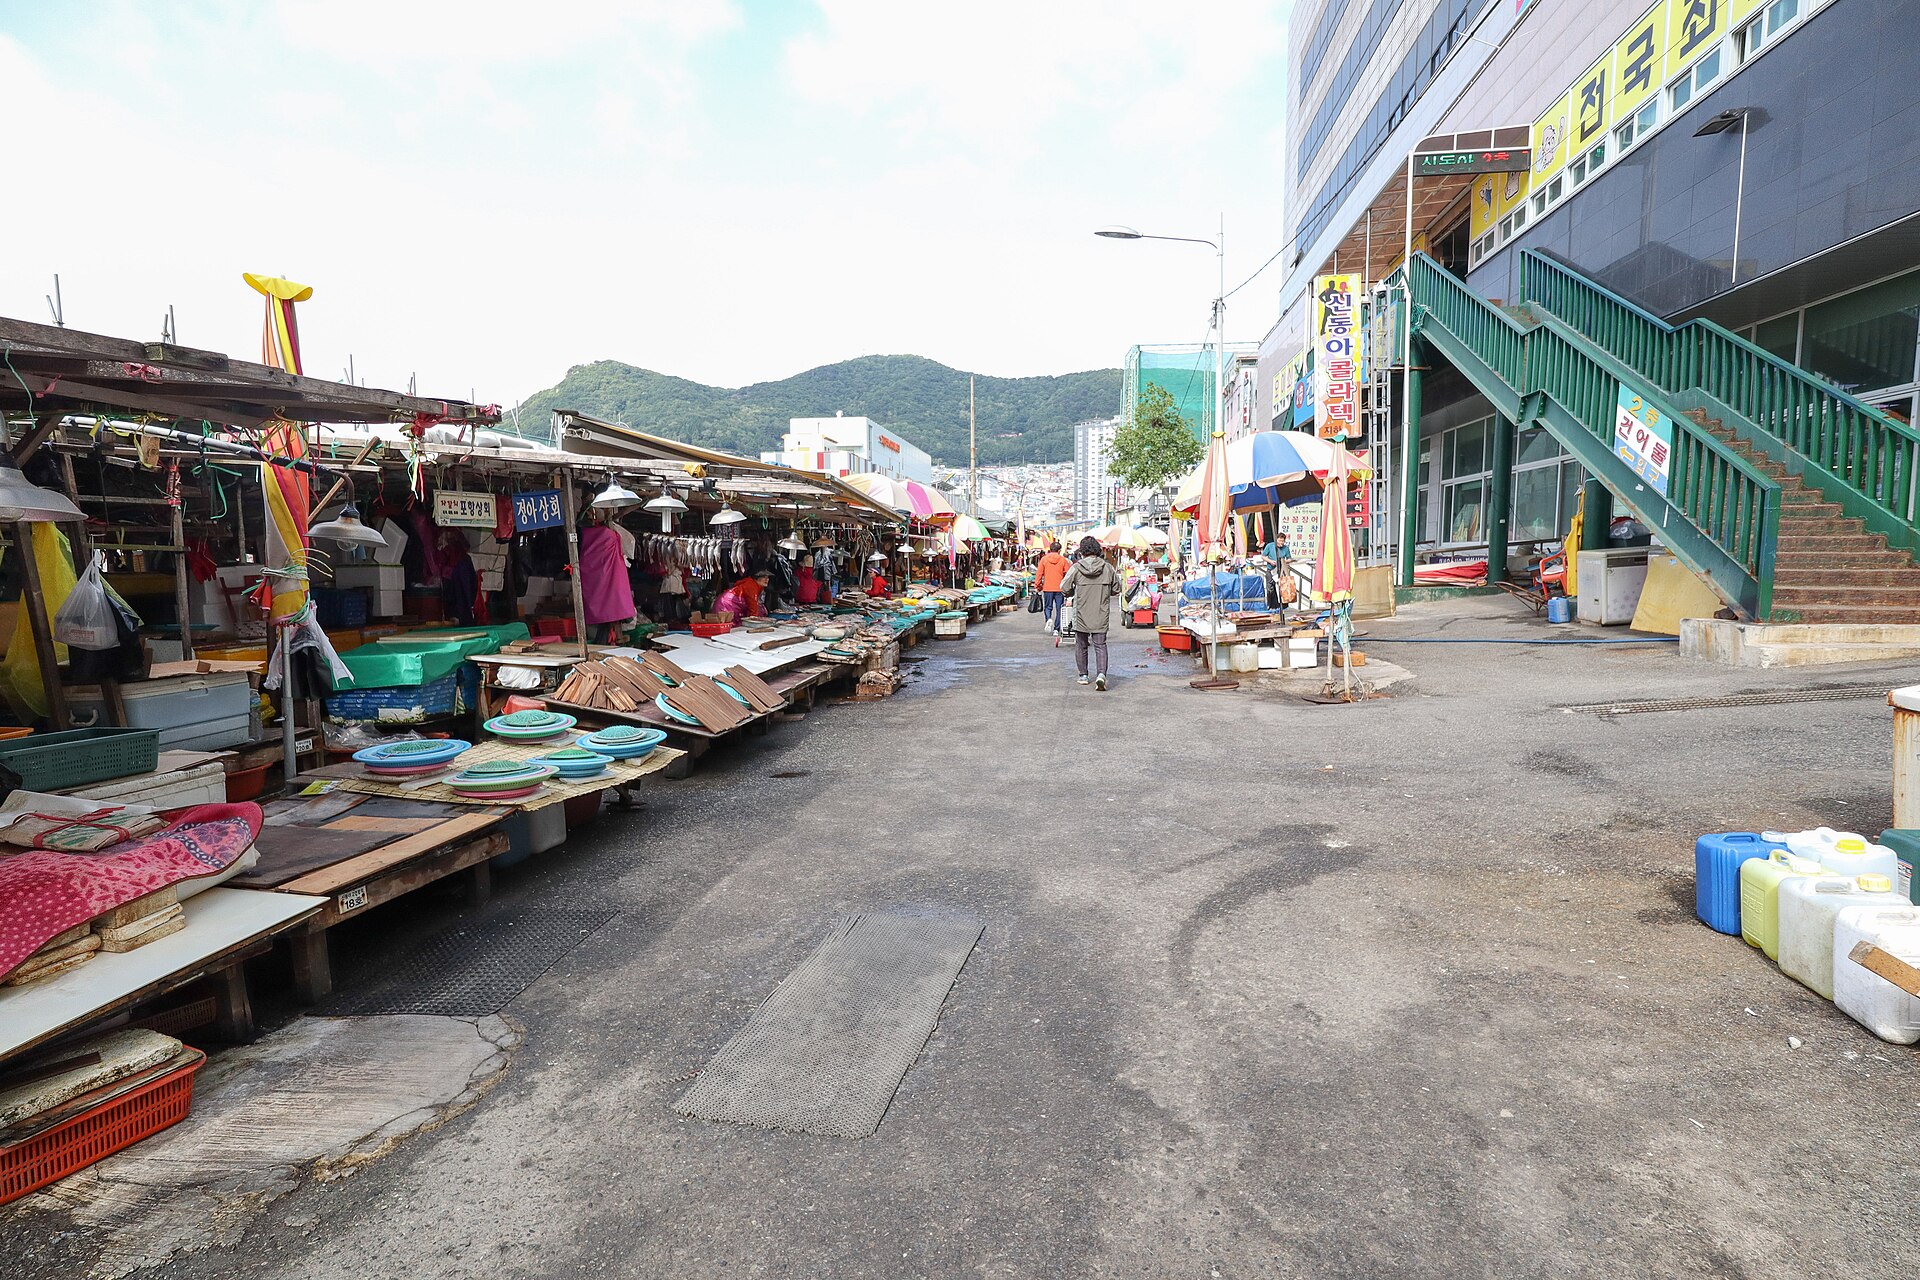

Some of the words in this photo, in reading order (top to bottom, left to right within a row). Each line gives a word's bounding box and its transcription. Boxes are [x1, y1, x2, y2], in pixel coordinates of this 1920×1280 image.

[1618, 415, 1667, 467] 건어물
[460, 500, 491, 517] 포항상회
[516, 494, 562, 525] 정아상회
